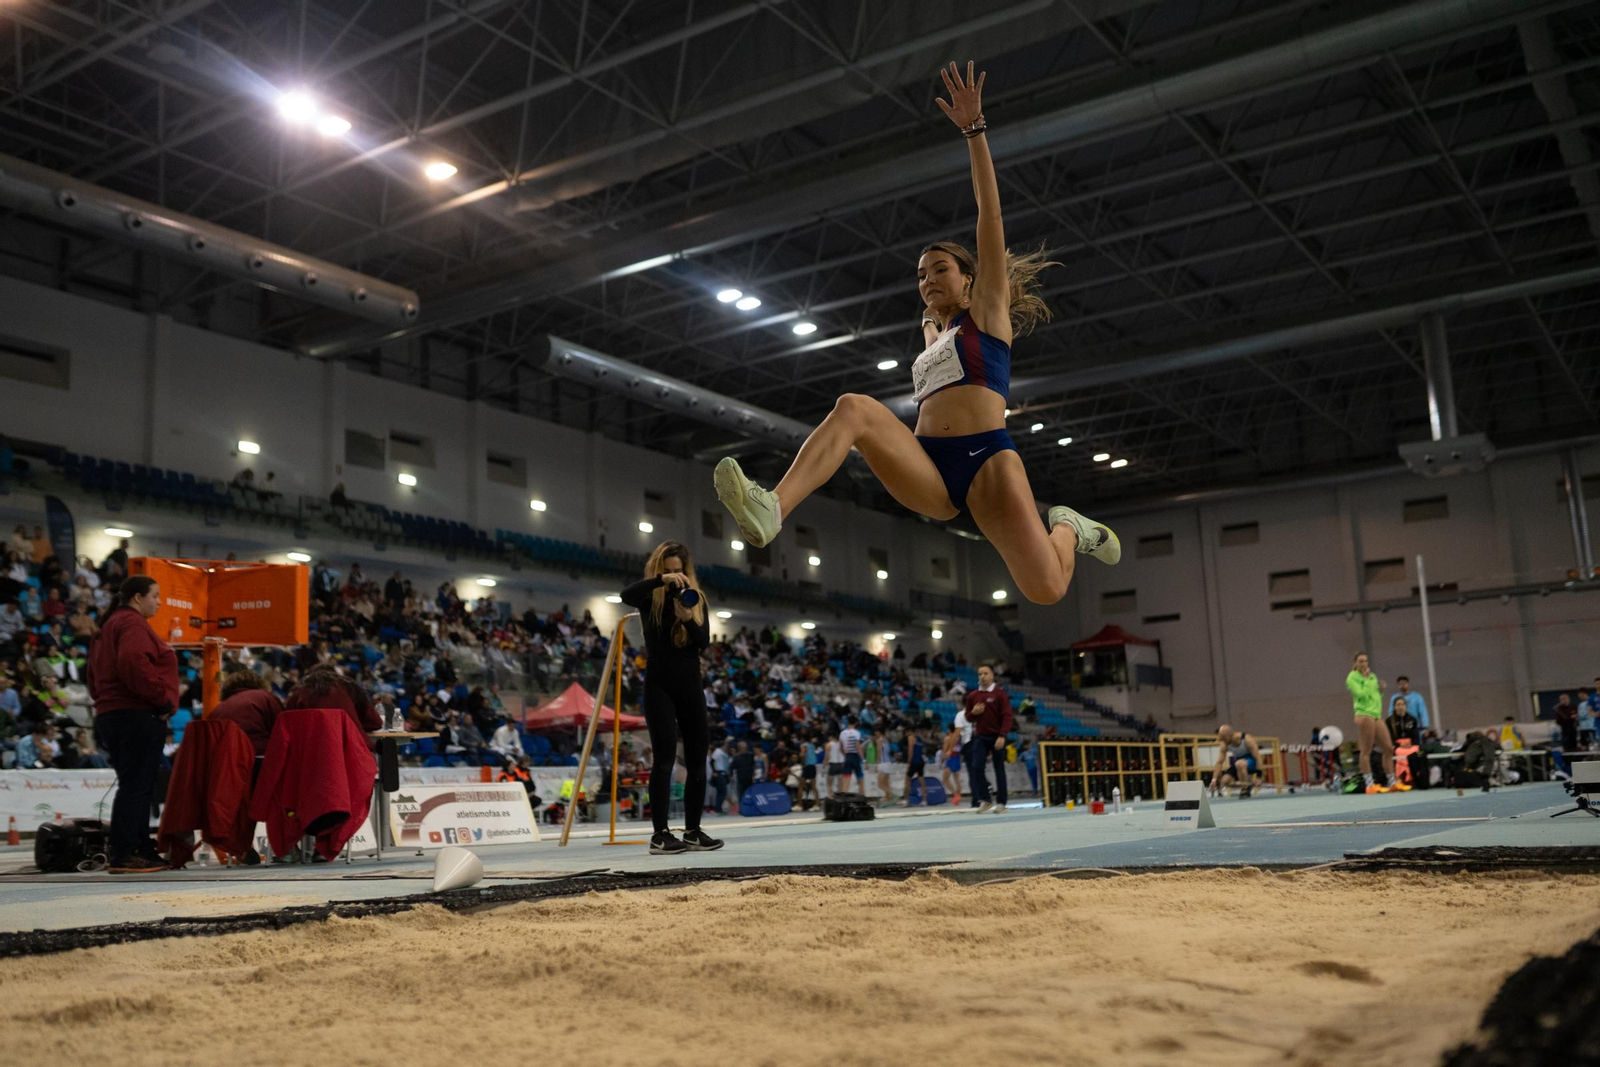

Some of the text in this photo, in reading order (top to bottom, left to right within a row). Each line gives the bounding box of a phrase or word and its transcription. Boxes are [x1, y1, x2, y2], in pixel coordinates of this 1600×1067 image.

[167, 597, 192, 610] MONDO
[233, 600, 271, 610] MONDO
[456, 810, 510, 818] atletismofaa.es
[486, 828, 531, 838] @atletismoFAA
